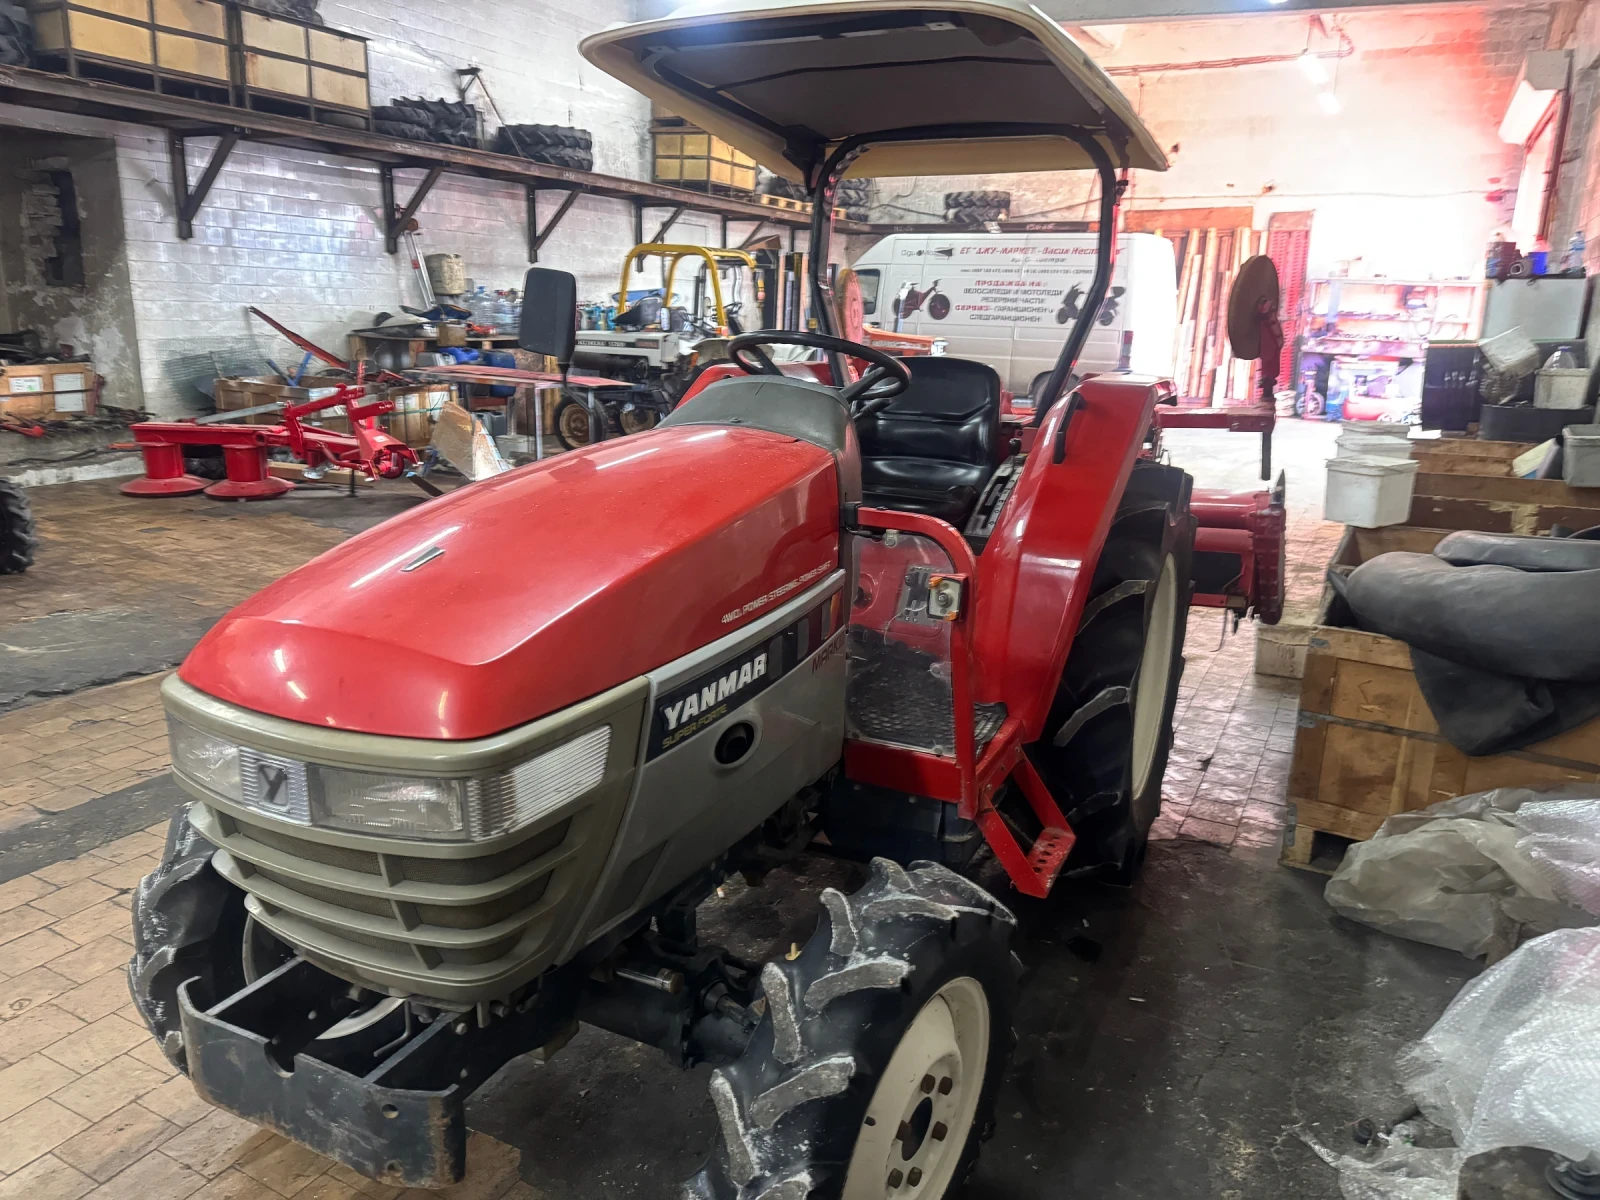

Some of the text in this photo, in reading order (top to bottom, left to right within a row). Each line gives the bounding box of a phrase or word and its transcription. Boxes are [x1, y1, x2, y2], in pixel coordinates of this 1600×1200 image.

[963, 287, 1011, 295] ВЕЛОСИПЕДИ
[1019, 297, 1045, 305] ЧАСТИ
[742, 594, 768, 616] POWER
[798, 569, 818, 584] POWER
[664, 652, 768, 731] YANMAR
[662, 703, 729, 749] SUPER FORTE
